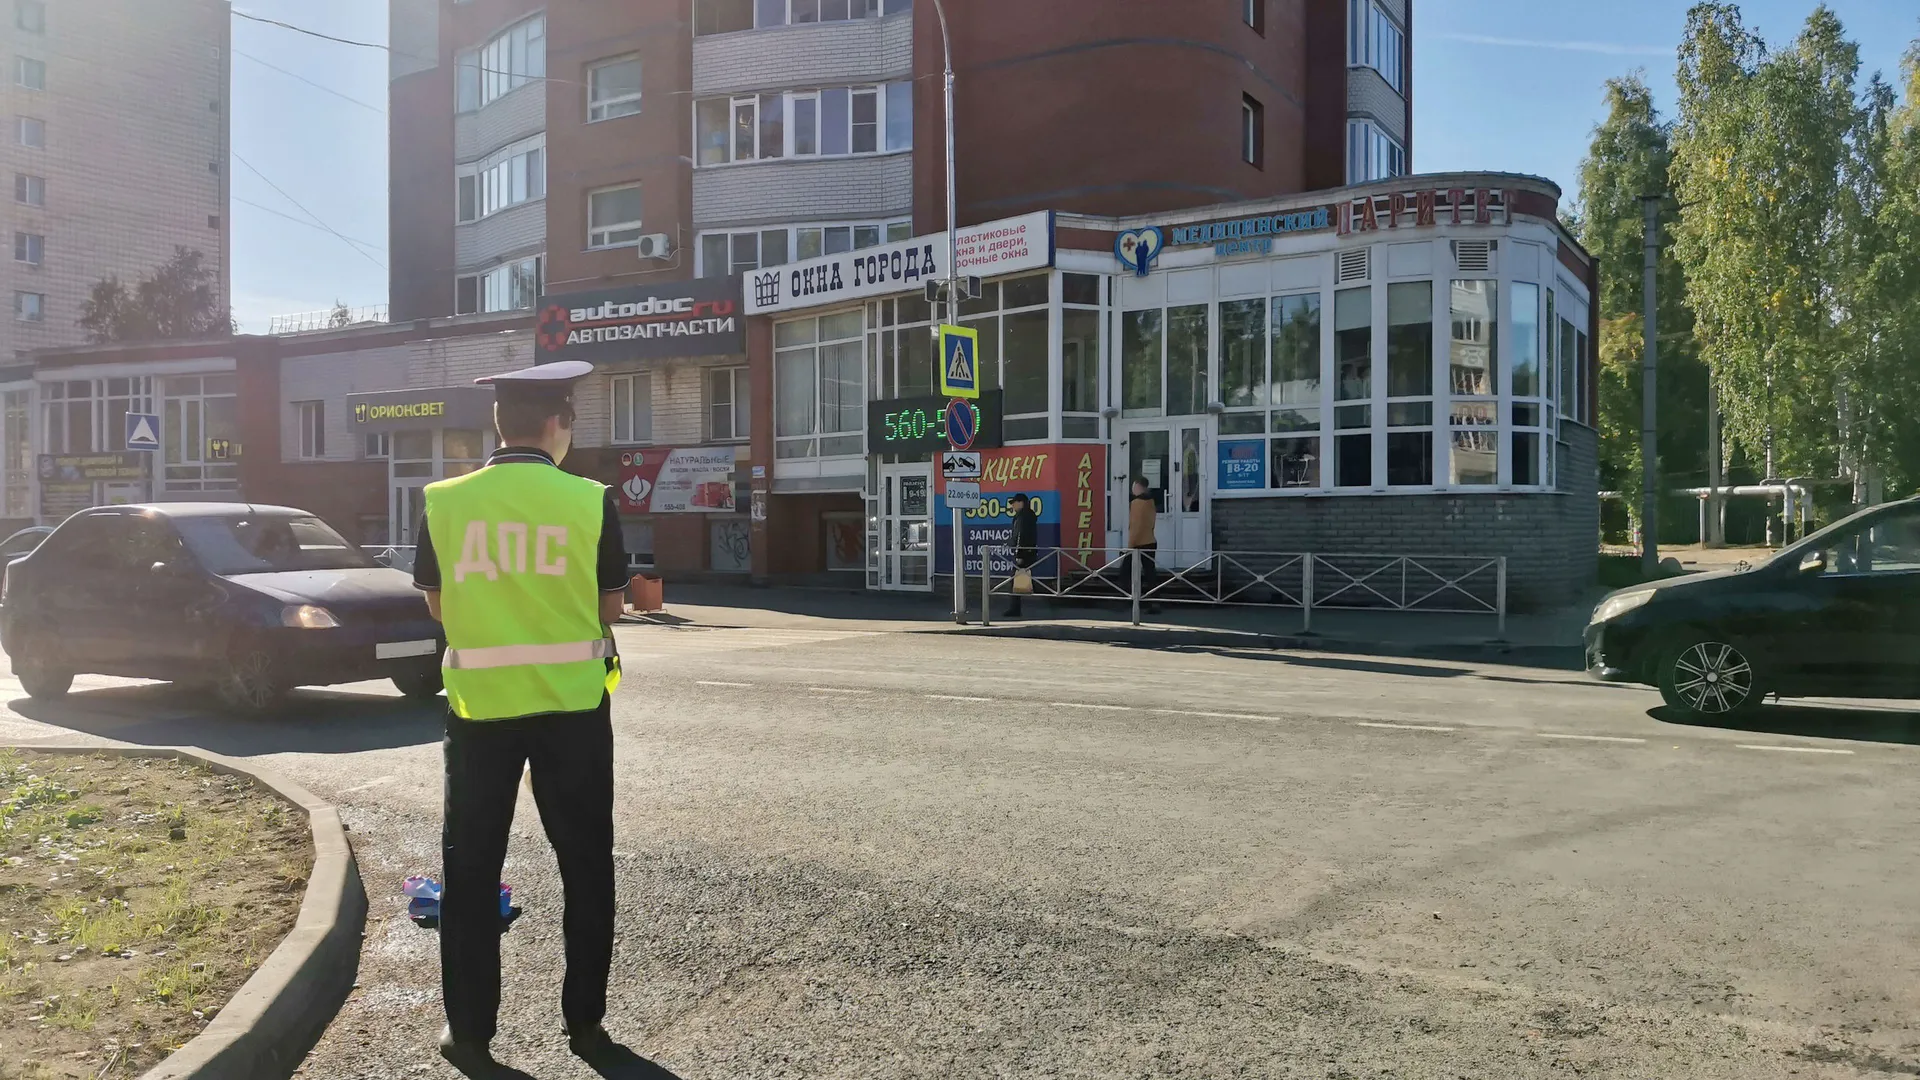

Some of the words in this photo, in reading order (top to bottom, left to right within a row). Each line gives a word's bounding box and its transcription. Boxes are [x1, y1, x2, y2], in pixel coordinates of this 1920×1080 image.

[956, 224, 1027, 245] ластиковые
[1172, 207, 1330, 246] МЕДИЦИНСКИЙ
[956, 246, 975, 257] кна
[988, 237, 1027, 253] двери,
[956, 253, 998, 268] рочные
[1001, 248, 1029, 260] окна
[791, 262, 843, 298] ОКНА
[854, 244, 936, 286] ГОРОДА
[566, 316, 735, 345] АВТОЗАПЧАСТИ
[370, 402, 444, 418] ОРИОНСВЕТ
[885, 404, 980, 440] 560-50
[970, 454, 1048, 487] КЦЕНТ
[1233, 463, 1259, 472] 8-20
[947, 489, 979, 500] 22.00-6.00
[1077, 452, 1093, 566] АКЦЕНТ
[454, 520, 568, 582] ДПС
